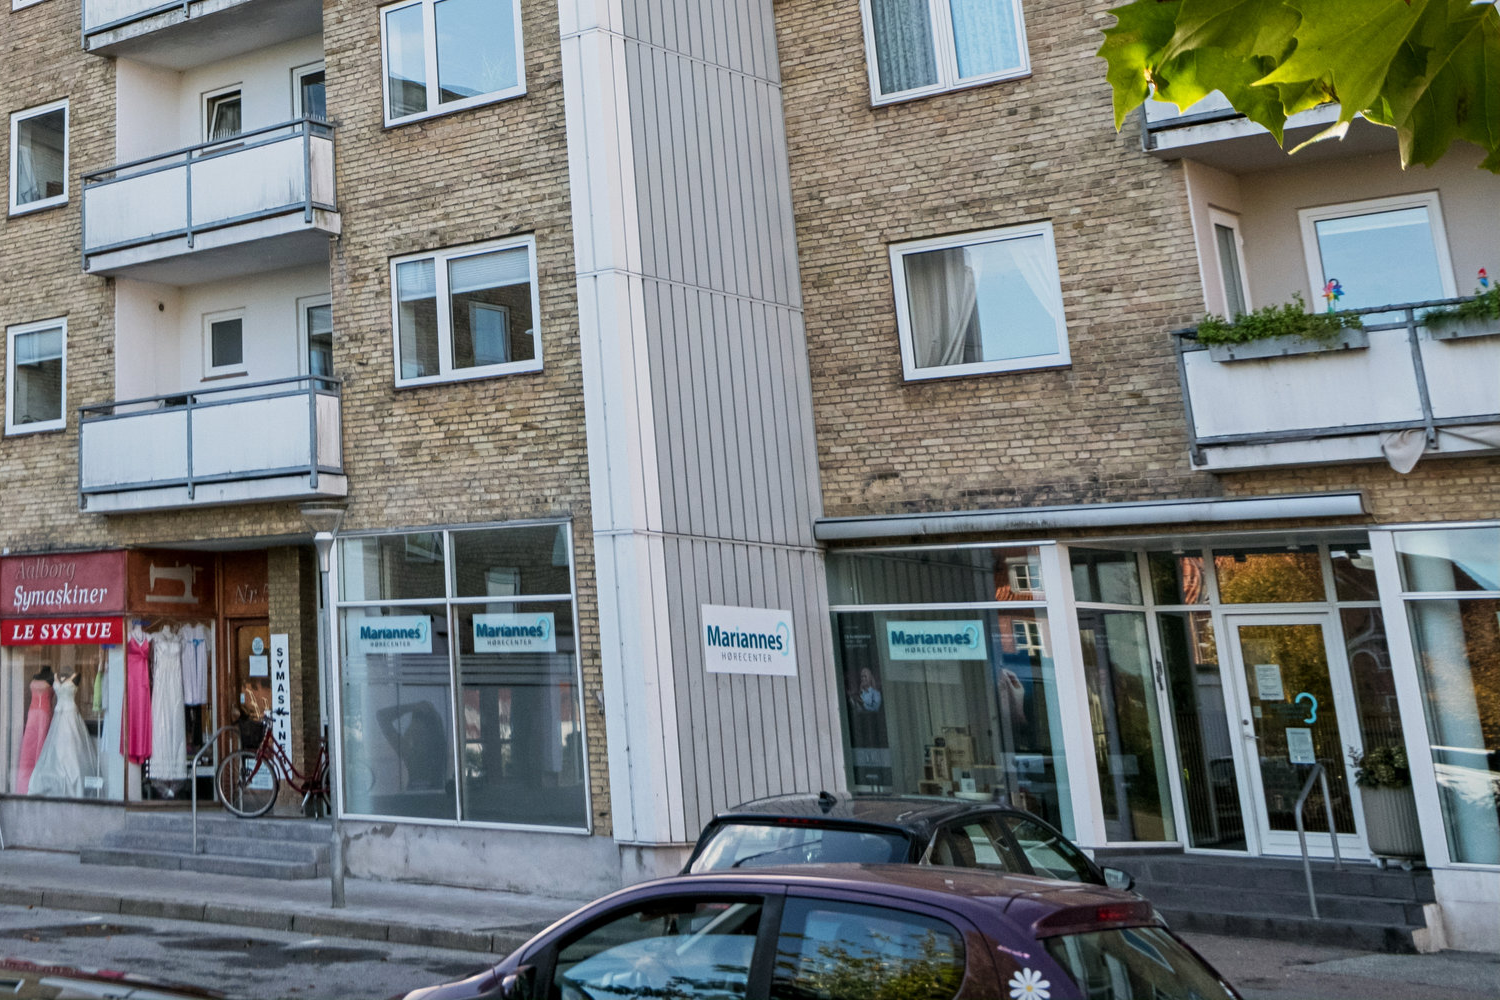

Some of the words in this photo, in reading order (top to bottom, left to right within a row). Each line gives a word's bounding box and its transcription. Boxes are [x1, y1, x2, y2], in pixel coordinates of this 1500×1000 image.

[16, 559, 76, 581] Aalborg
[13, 582, 108, 614] Symaskiner
[12, 624, 35, 641] LE
[40, 622, 112, 640] SYSTUE
[360, 625, 421, 641] Mariannes
[476, 622, 543, 638] Mariannes
[706, 625, 783, 651] Mariannes
[891, 630, 971, 646] Mariannes
[370, 640, 411, 648] HØRECENTER
[487, 639, 532, 647] HØRECENTER
[905, 646, 958, 654] HØRECENTER
[721, 650, 773, 663] HØRECENTER
